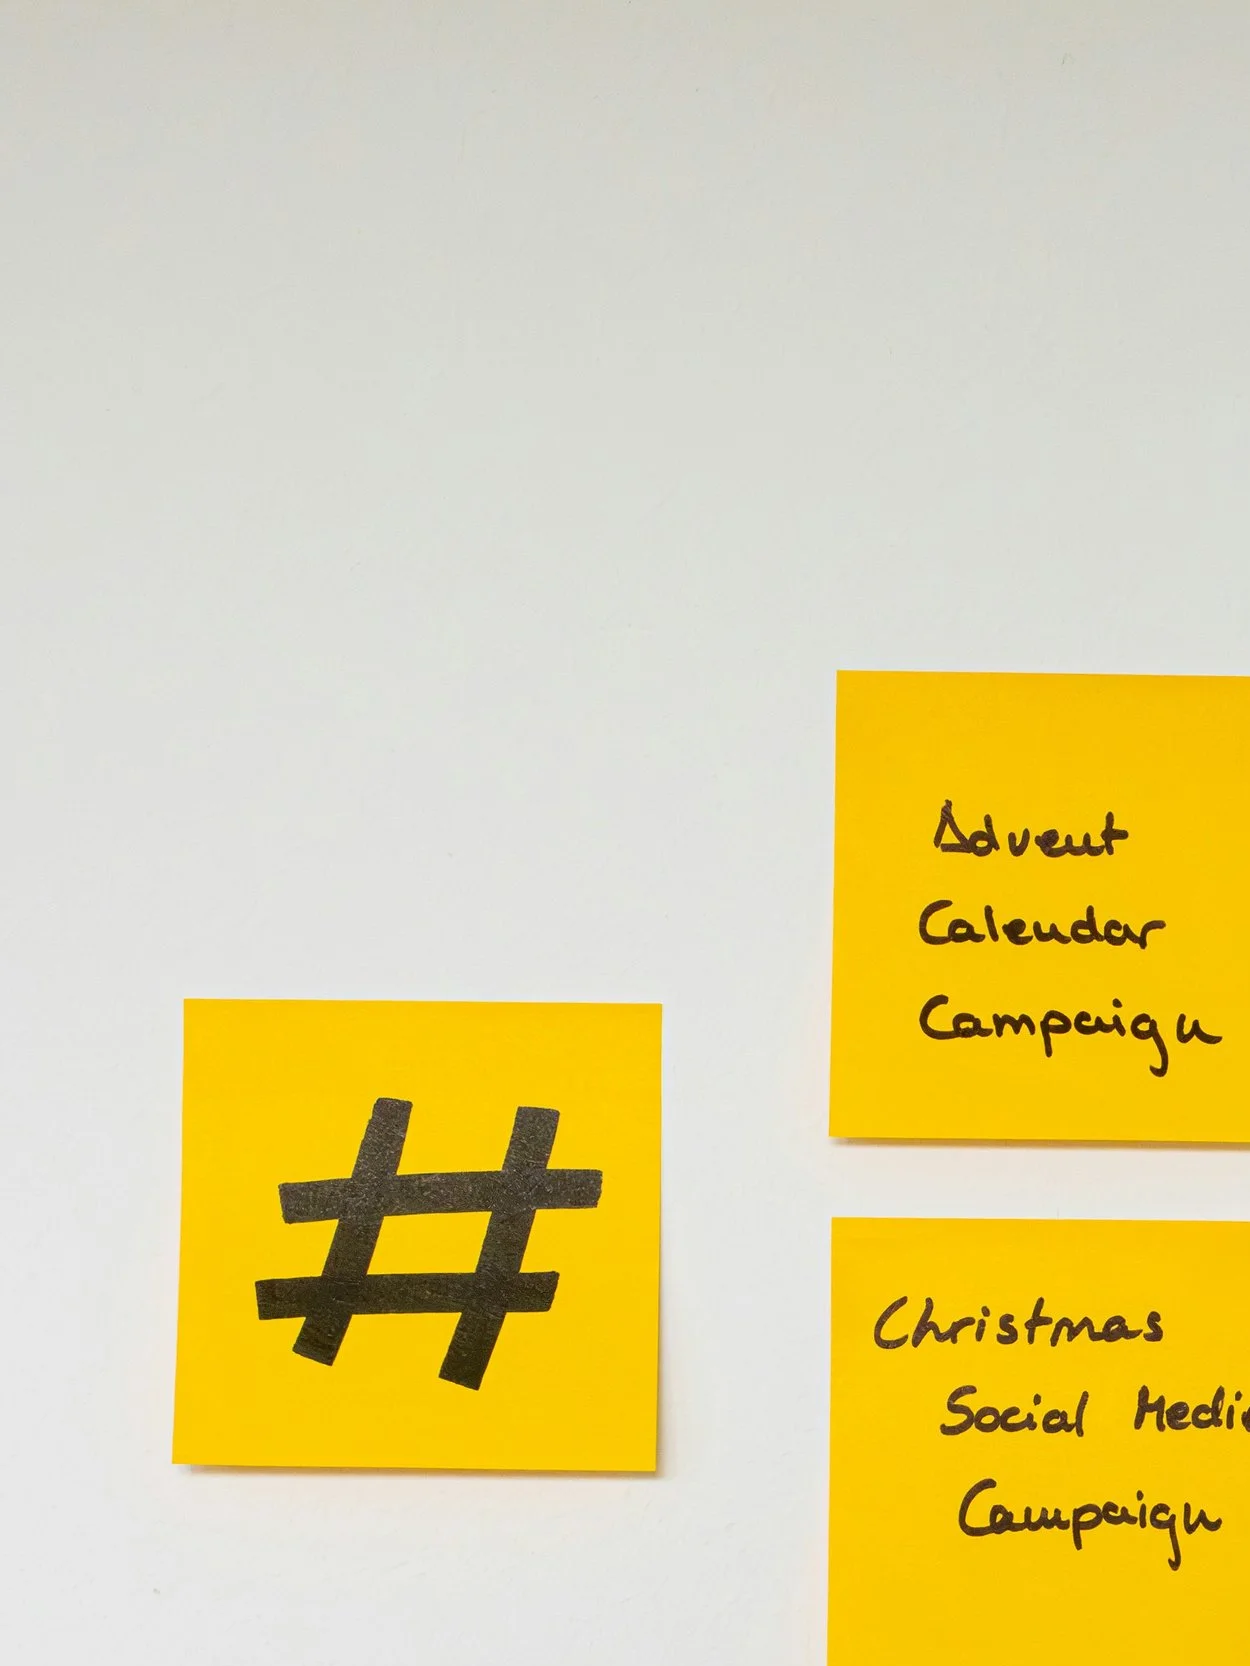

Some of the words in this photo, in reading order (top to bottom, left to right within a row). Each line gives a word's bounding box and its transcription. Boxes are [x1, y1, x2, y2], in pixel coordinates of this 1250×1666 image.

[932, 798, 1130, 859] Advent
[917, 898, 1167, 951] Calendar
[917, 993, 1224, 1079] Campaign
[253, 1096, 604, 1392] #
[872, 1294, 1165, 1351] Christmas
[938, 1384, 1090, 1439] Social
[957, 1477, 1224, 1572] Campaign
